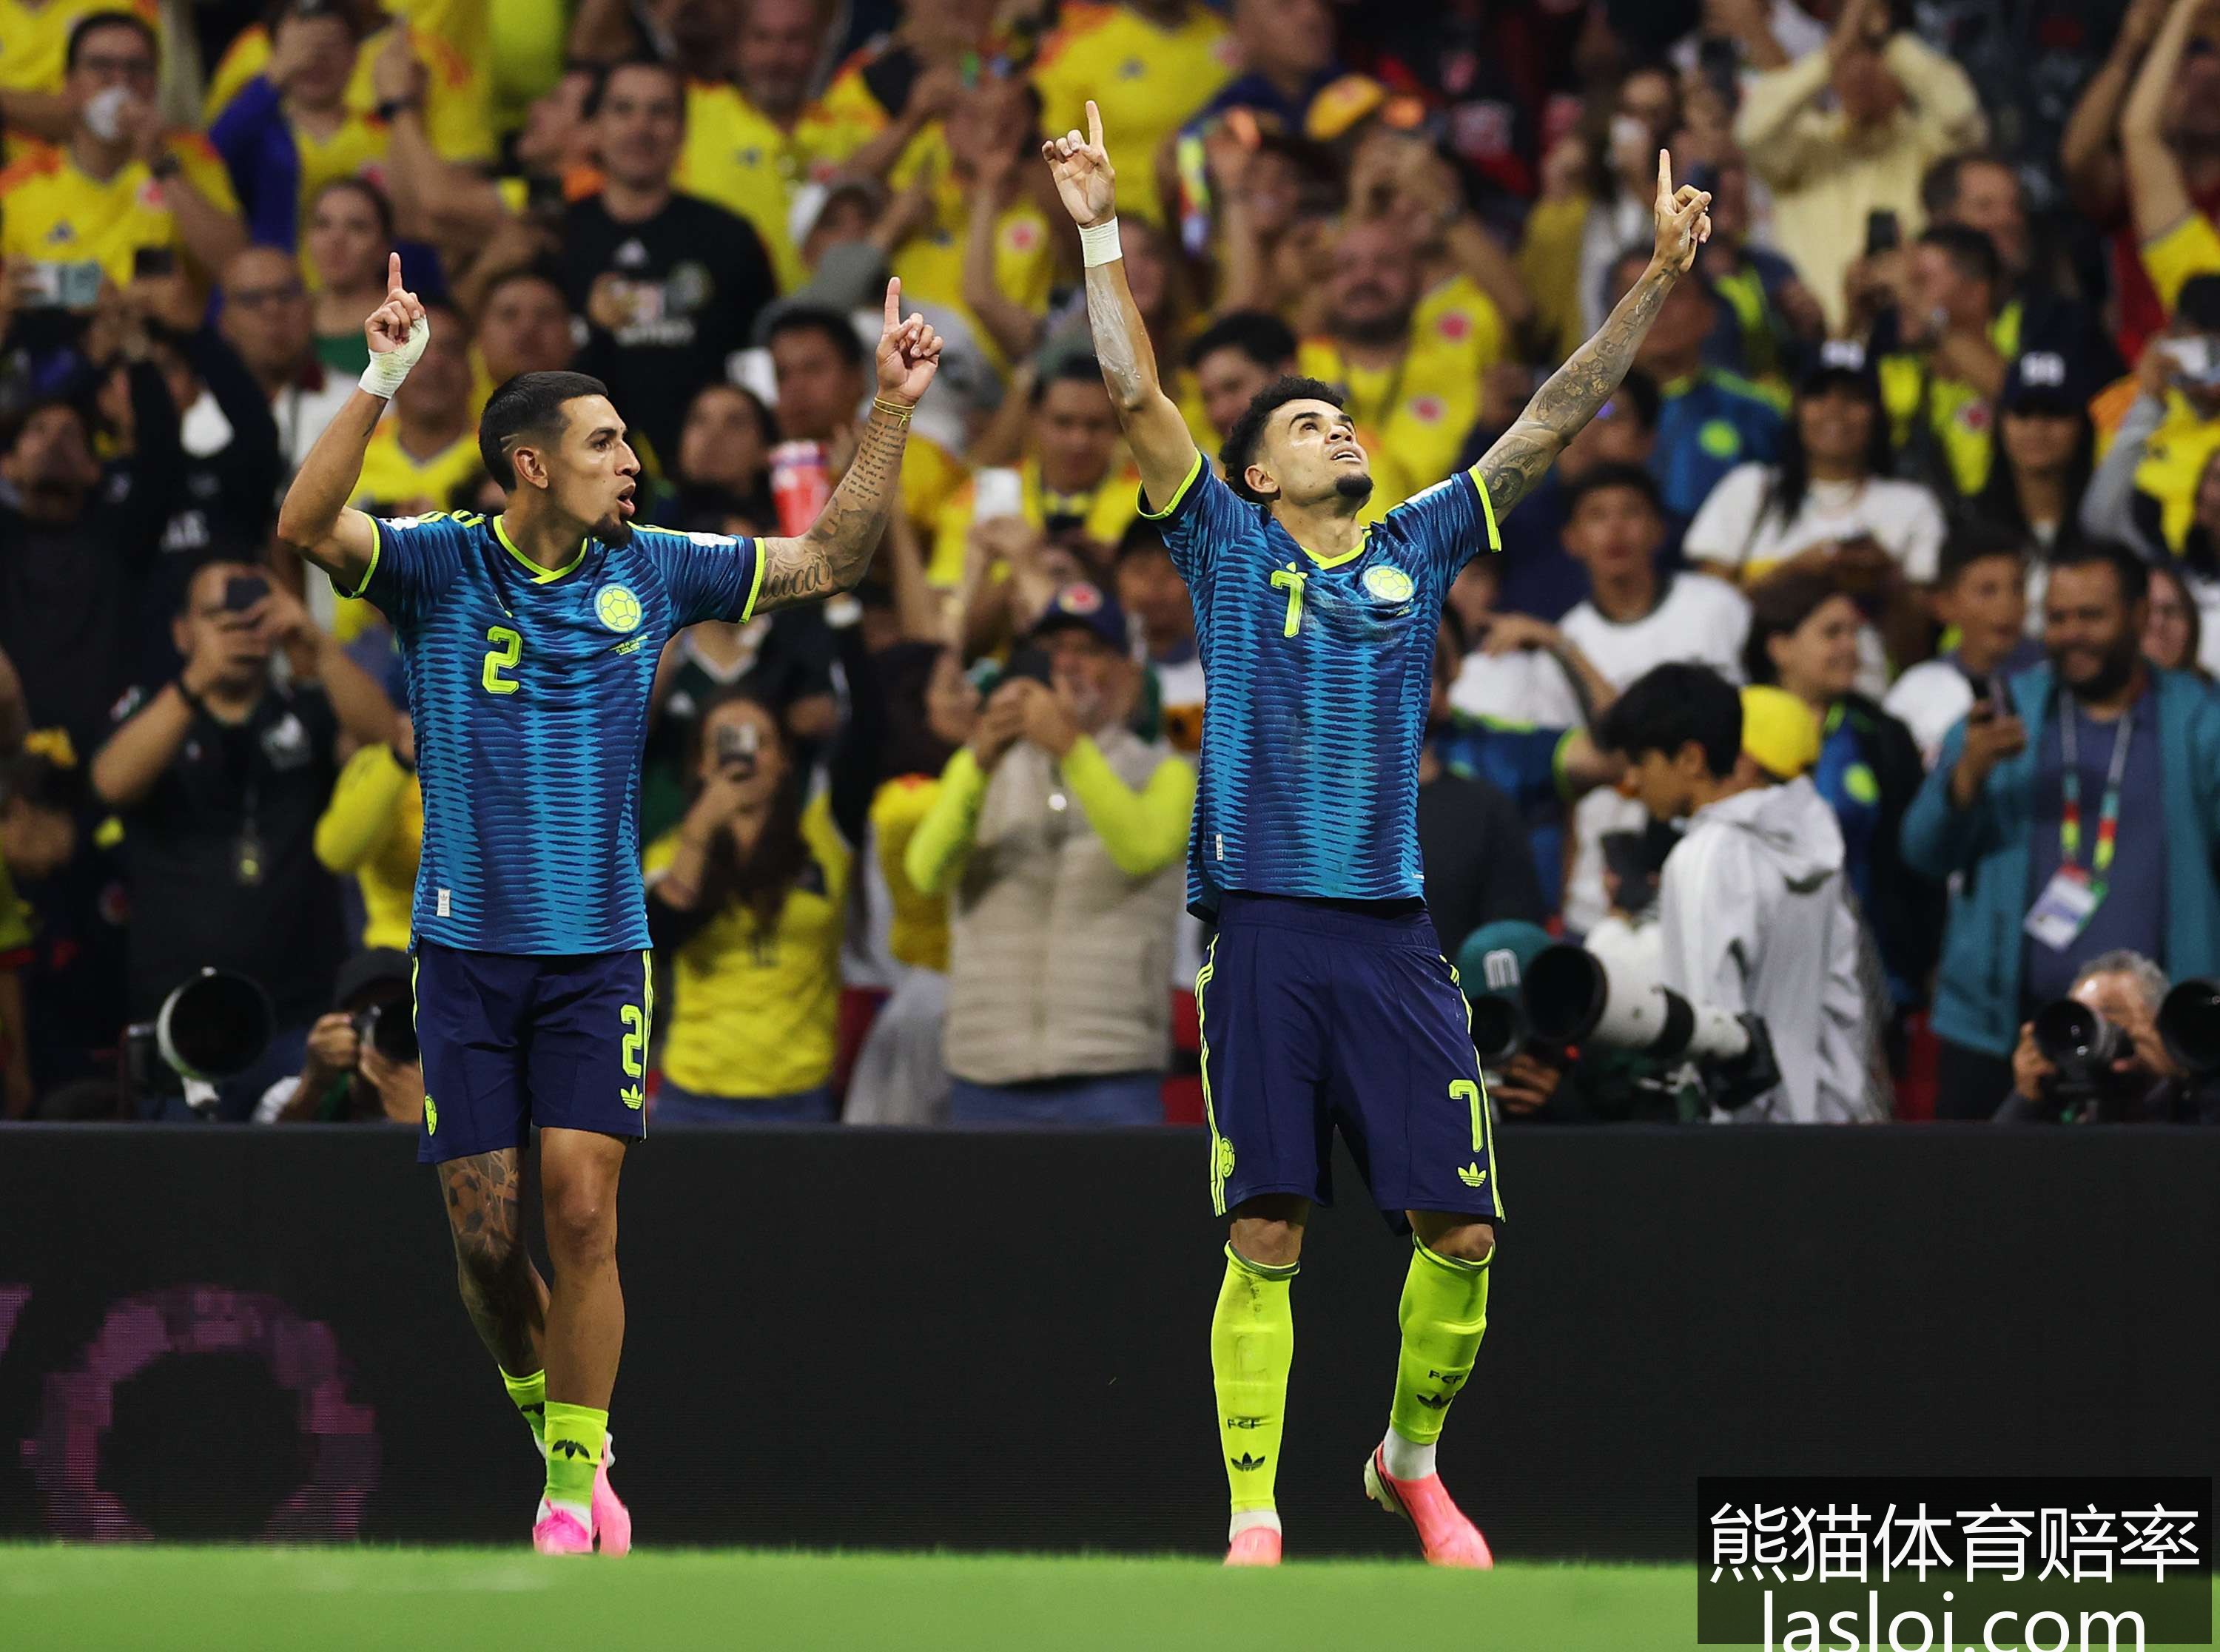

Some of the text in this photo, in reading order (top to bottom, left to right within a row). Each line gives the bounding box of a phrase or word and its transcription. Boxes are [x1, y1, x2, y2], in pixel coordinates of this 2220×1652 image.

[1270, 570, 1305, 638] 7
[482, 625, 522, 695] 2
[620, 1004, 642, 1079] 2
[1448, 1079, 1484, 1153] 7
